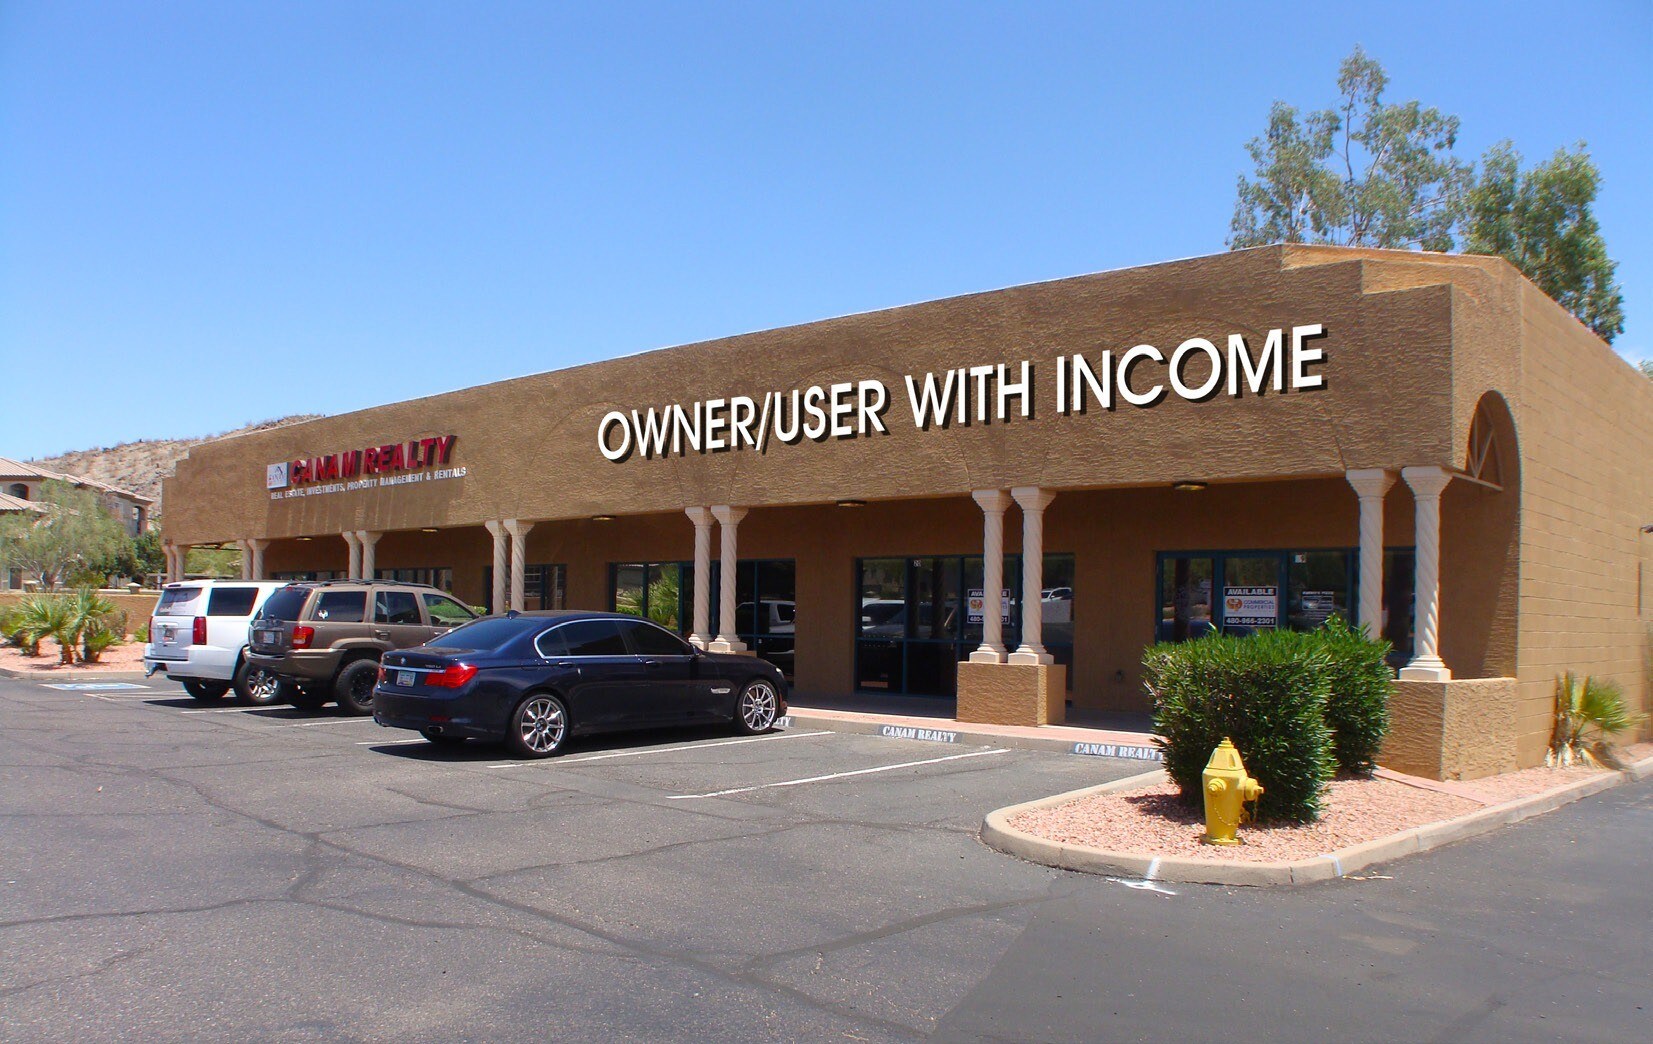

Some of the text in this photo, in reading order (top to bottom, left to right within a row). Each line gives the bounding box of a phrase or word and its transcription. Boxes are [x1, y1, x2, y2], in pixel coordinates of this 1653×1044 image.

[290, 435, 456, 485] CANAM REALTY
[270, 492, 284, 500] REAL
[346, 479, 377, 491] PROPERTY
[380, 472, 423, 486] MANAGEMENT
[425, 472, 432, 481] &
[433, 467, 467, 480] RENTALS
[882, 726, 957, 743] CANAM REALTY
[1074, 743, 1116, 757] CANAM
